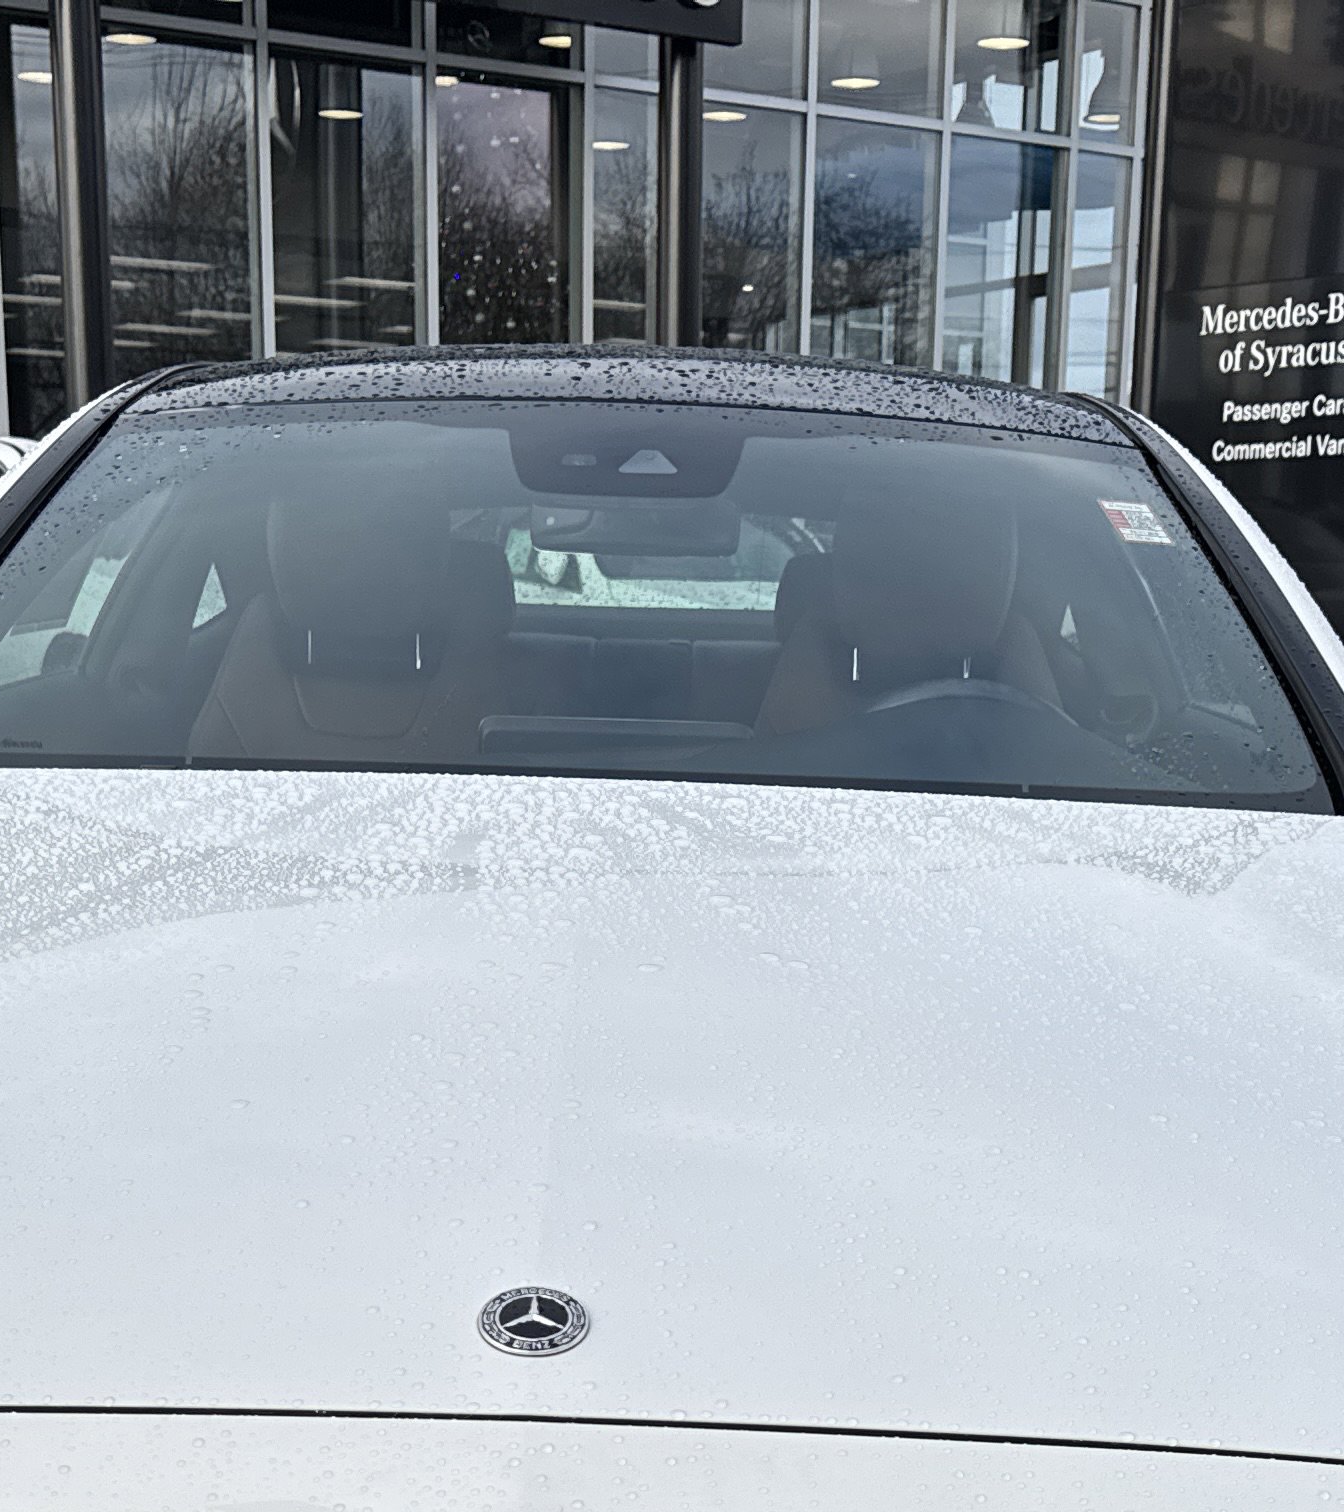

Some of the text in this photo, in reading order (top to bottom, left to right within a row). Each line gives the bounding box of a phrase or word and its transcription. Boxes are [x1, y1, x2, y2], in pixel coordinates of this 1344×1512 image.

[1218, 341, 1246, 373] of
[1222, 400, 1310, 424] Passenger
[1211, 435, 1313, 462] Commercial
